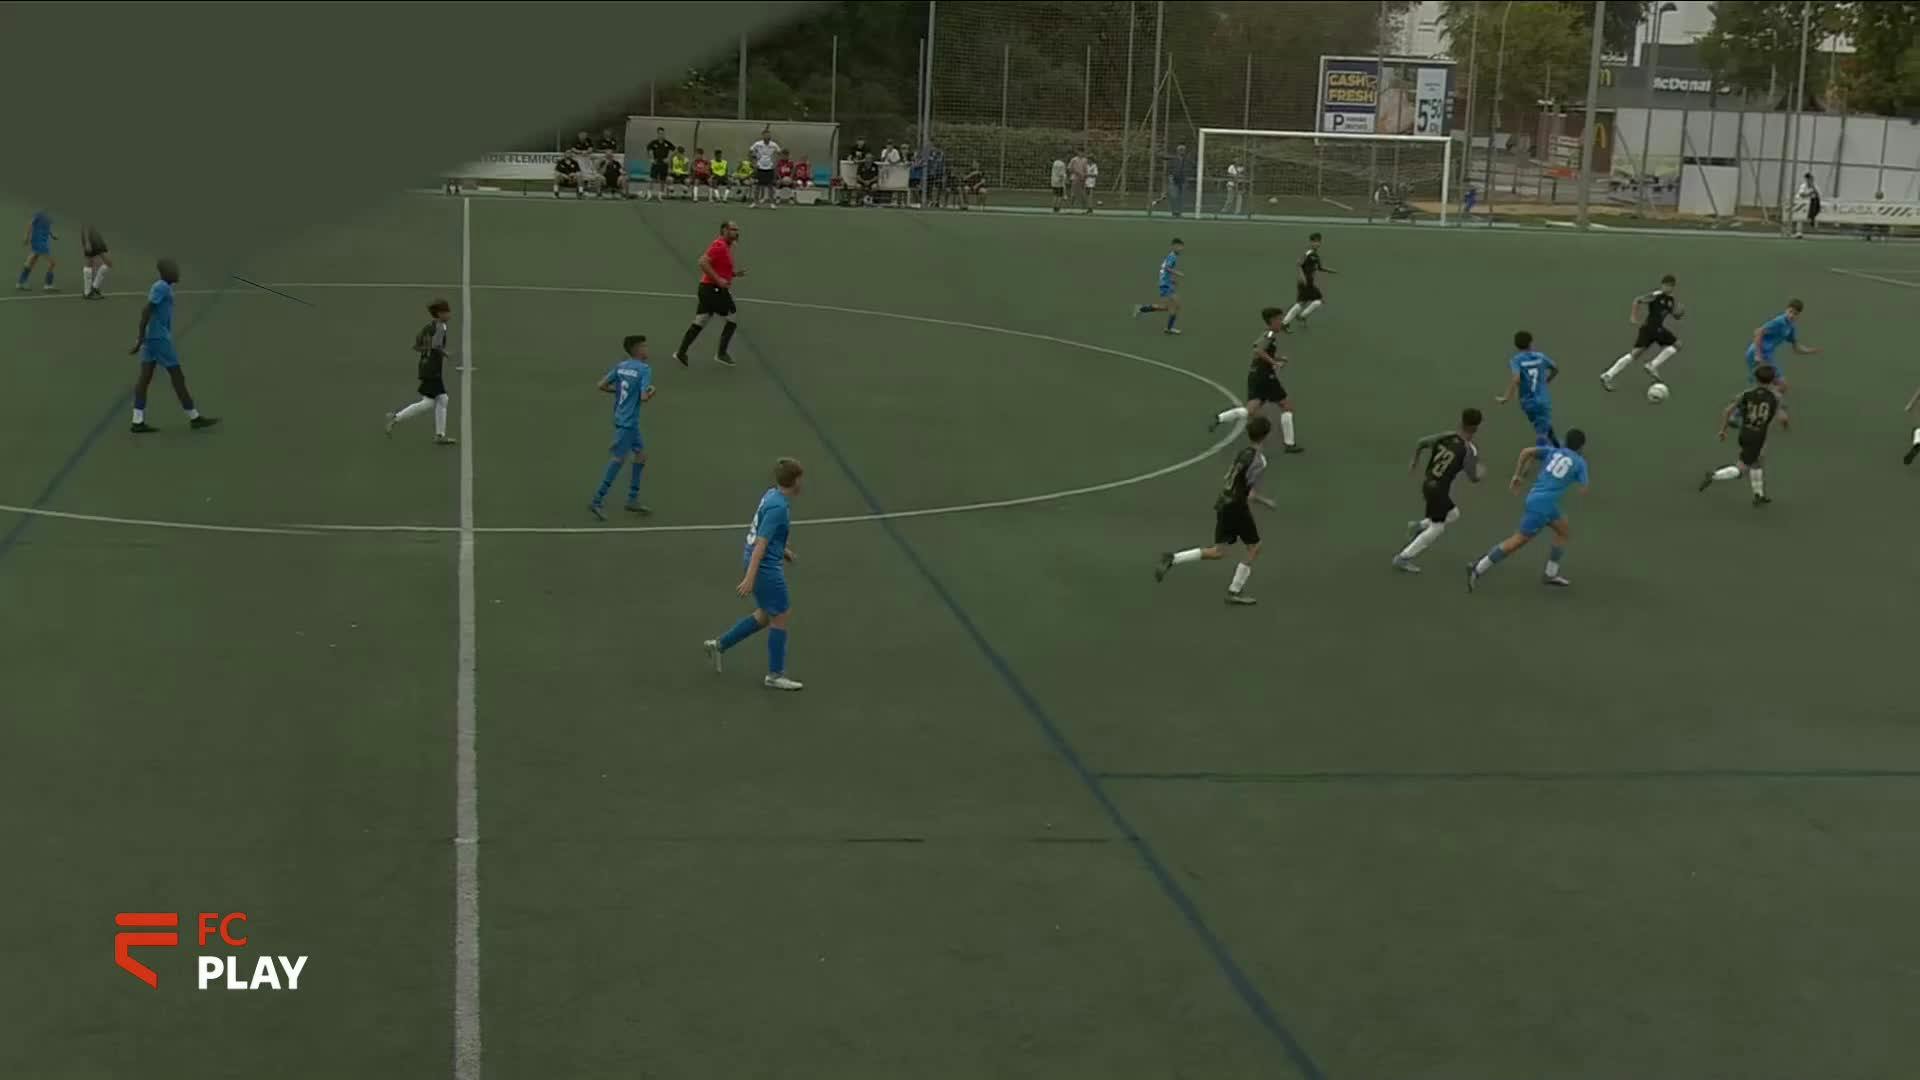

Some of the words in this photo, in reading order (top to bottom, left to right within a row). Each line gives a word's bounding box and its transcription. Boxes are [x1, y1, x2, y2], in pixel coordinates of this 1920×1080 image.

[1328, 75, 1366, 87] CASH
[1328, 89, 1374, 102] FRESH
[1333, 114, 1345, 130] P
[511, 153, 562, 164] FLEMING
[1528, 368, 1538, 392] 7
[1545, 452, 1573, 479] 16
